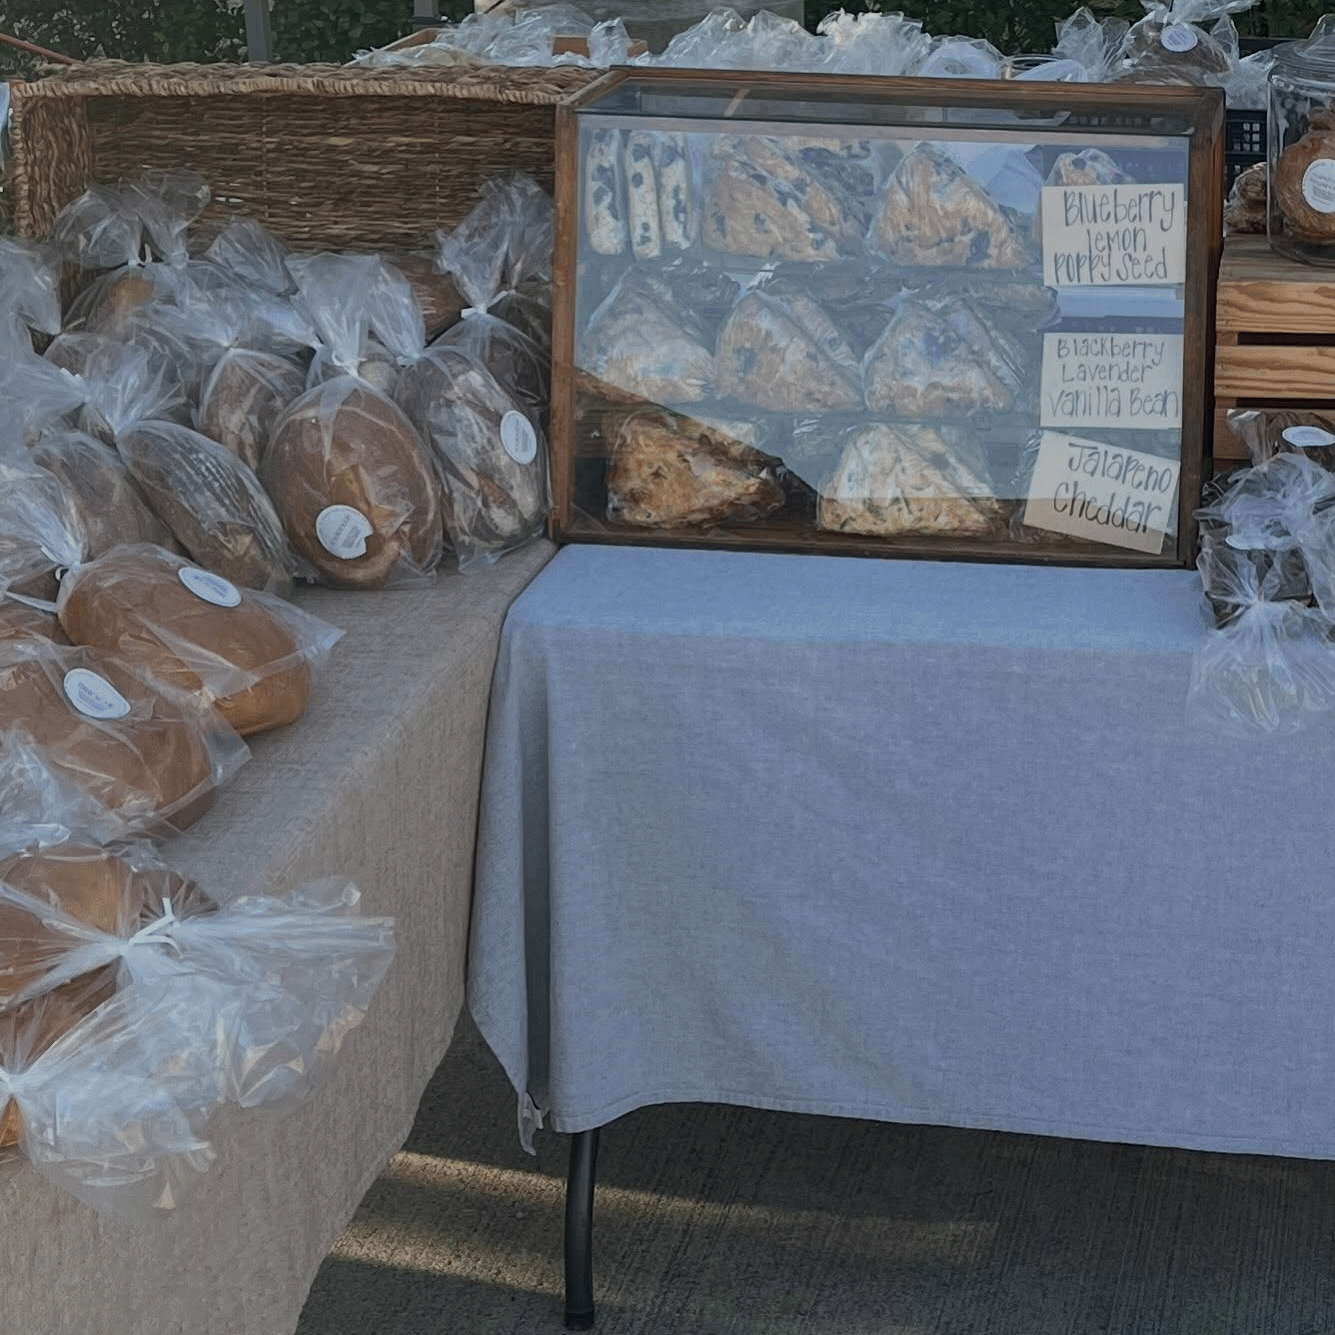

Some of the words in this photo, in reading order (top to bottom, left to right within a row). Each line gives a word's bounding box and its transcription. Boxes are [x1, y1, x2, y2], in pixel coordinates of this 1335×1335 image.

[1063, 188, 1175, 232] Blueberry
[1057, 336, 1165, 366] Blackberry
[1062, 360, 1153, 384] Lavender
[1129, 386, 1179, 418] Bean
